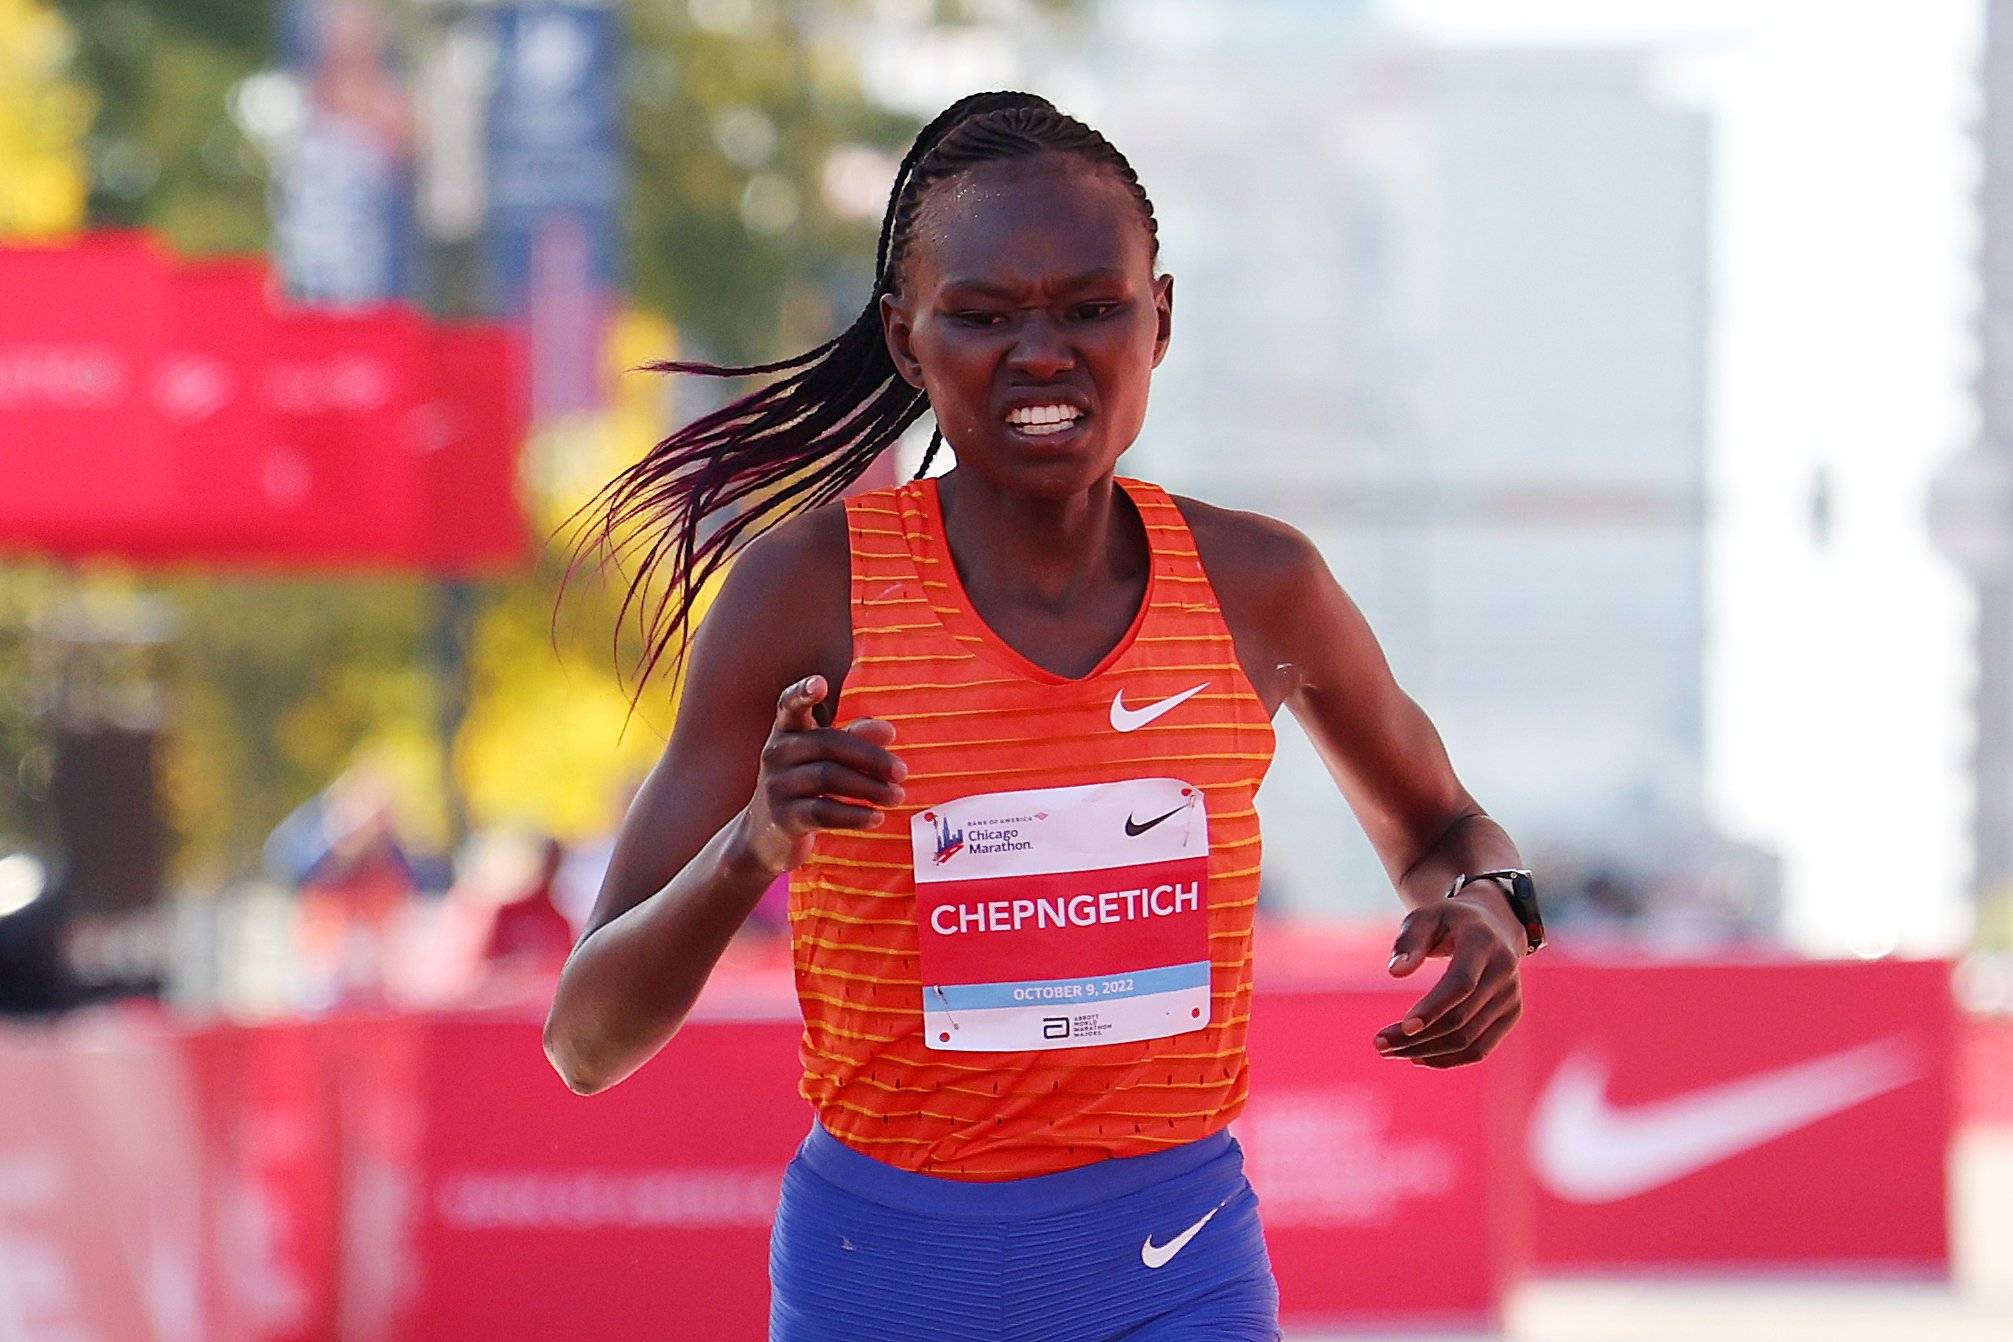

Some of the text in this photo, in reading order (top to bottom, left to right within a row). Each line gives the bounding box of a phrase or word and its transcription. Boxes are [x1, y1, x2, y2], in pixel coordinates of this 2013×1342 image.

[968, 829, 1019, 841] Chicago
[969, 840, 1032, 854] Marathon
[930, 881, 1198, 935] CHEPNGETICH
[1013, 979, 1134, 1000] OCTOBER 9, 2022
